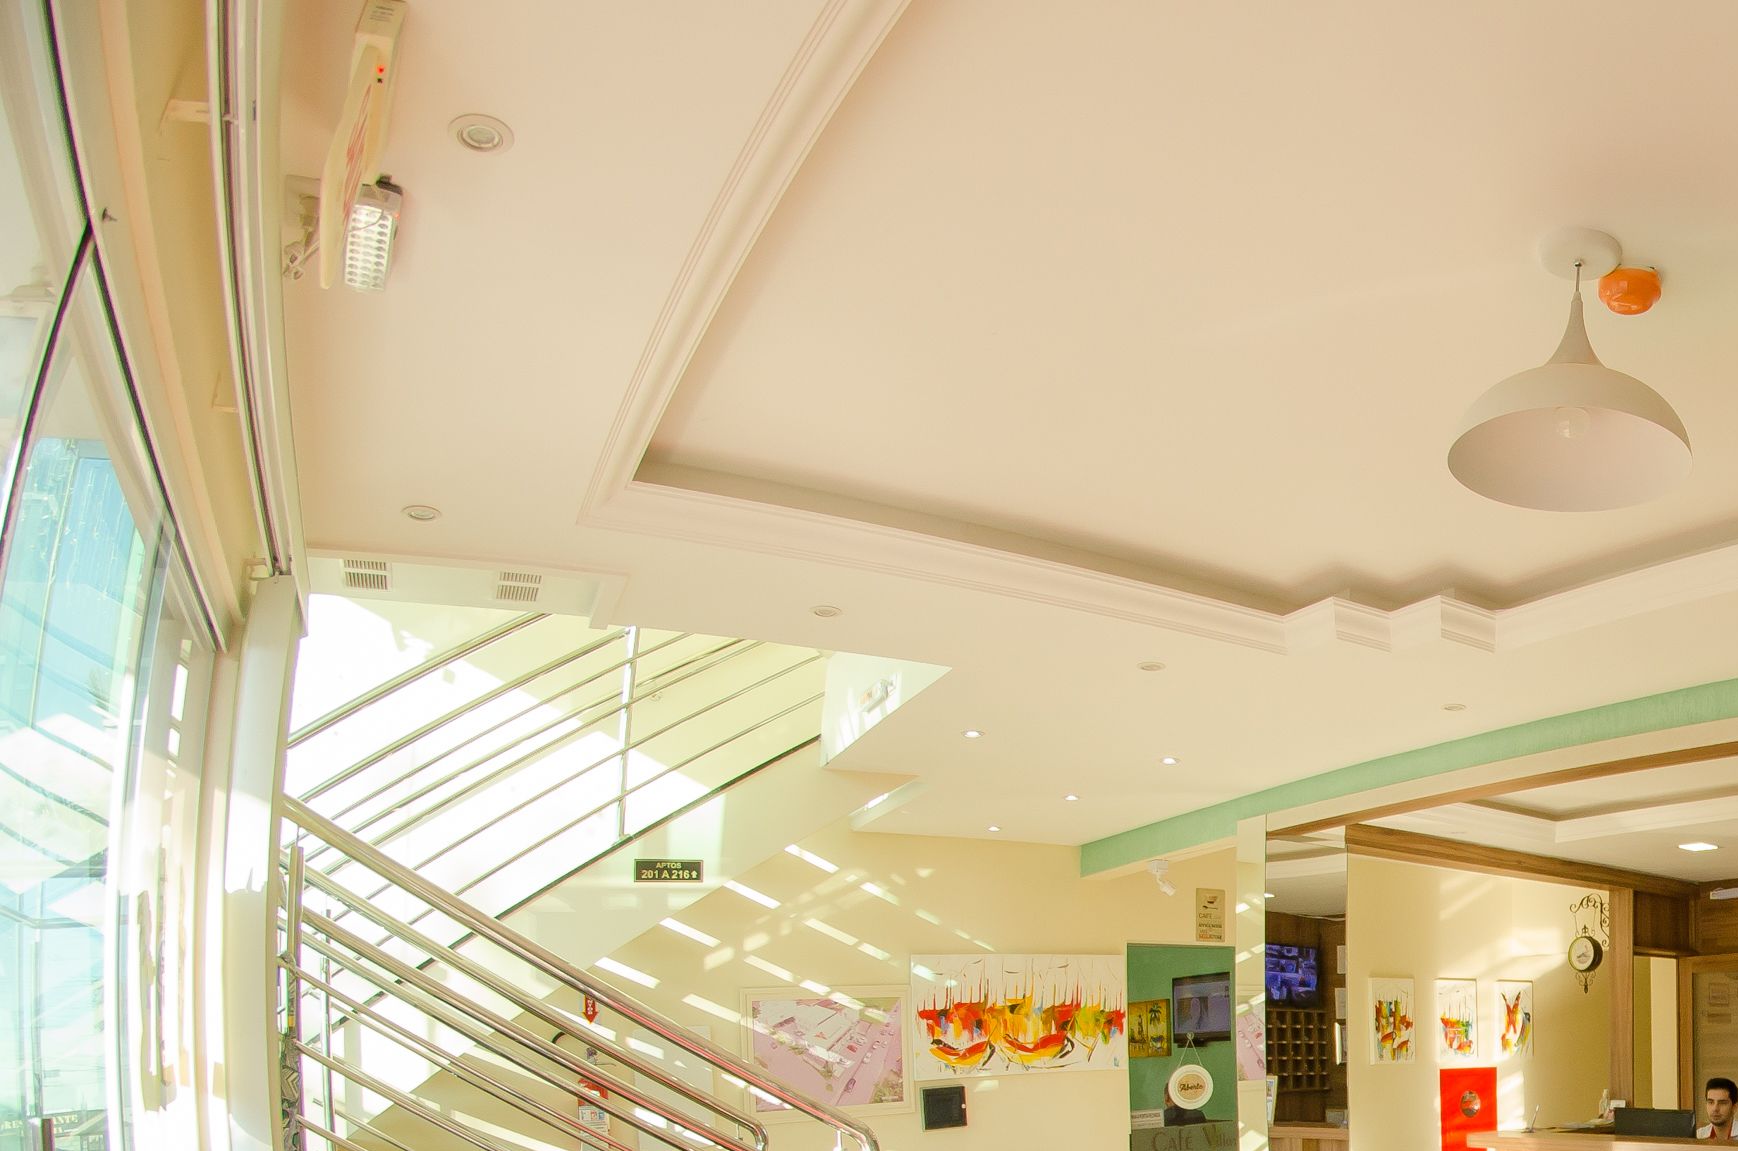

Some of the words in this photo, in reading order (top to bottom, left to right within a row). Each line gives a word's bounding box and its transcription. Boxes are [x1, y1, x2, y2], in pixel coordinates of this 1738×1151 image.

[641, 870, 659, 879] 201
[661, 870, 670, 878] A
[671, 870, 690, 879] 216
